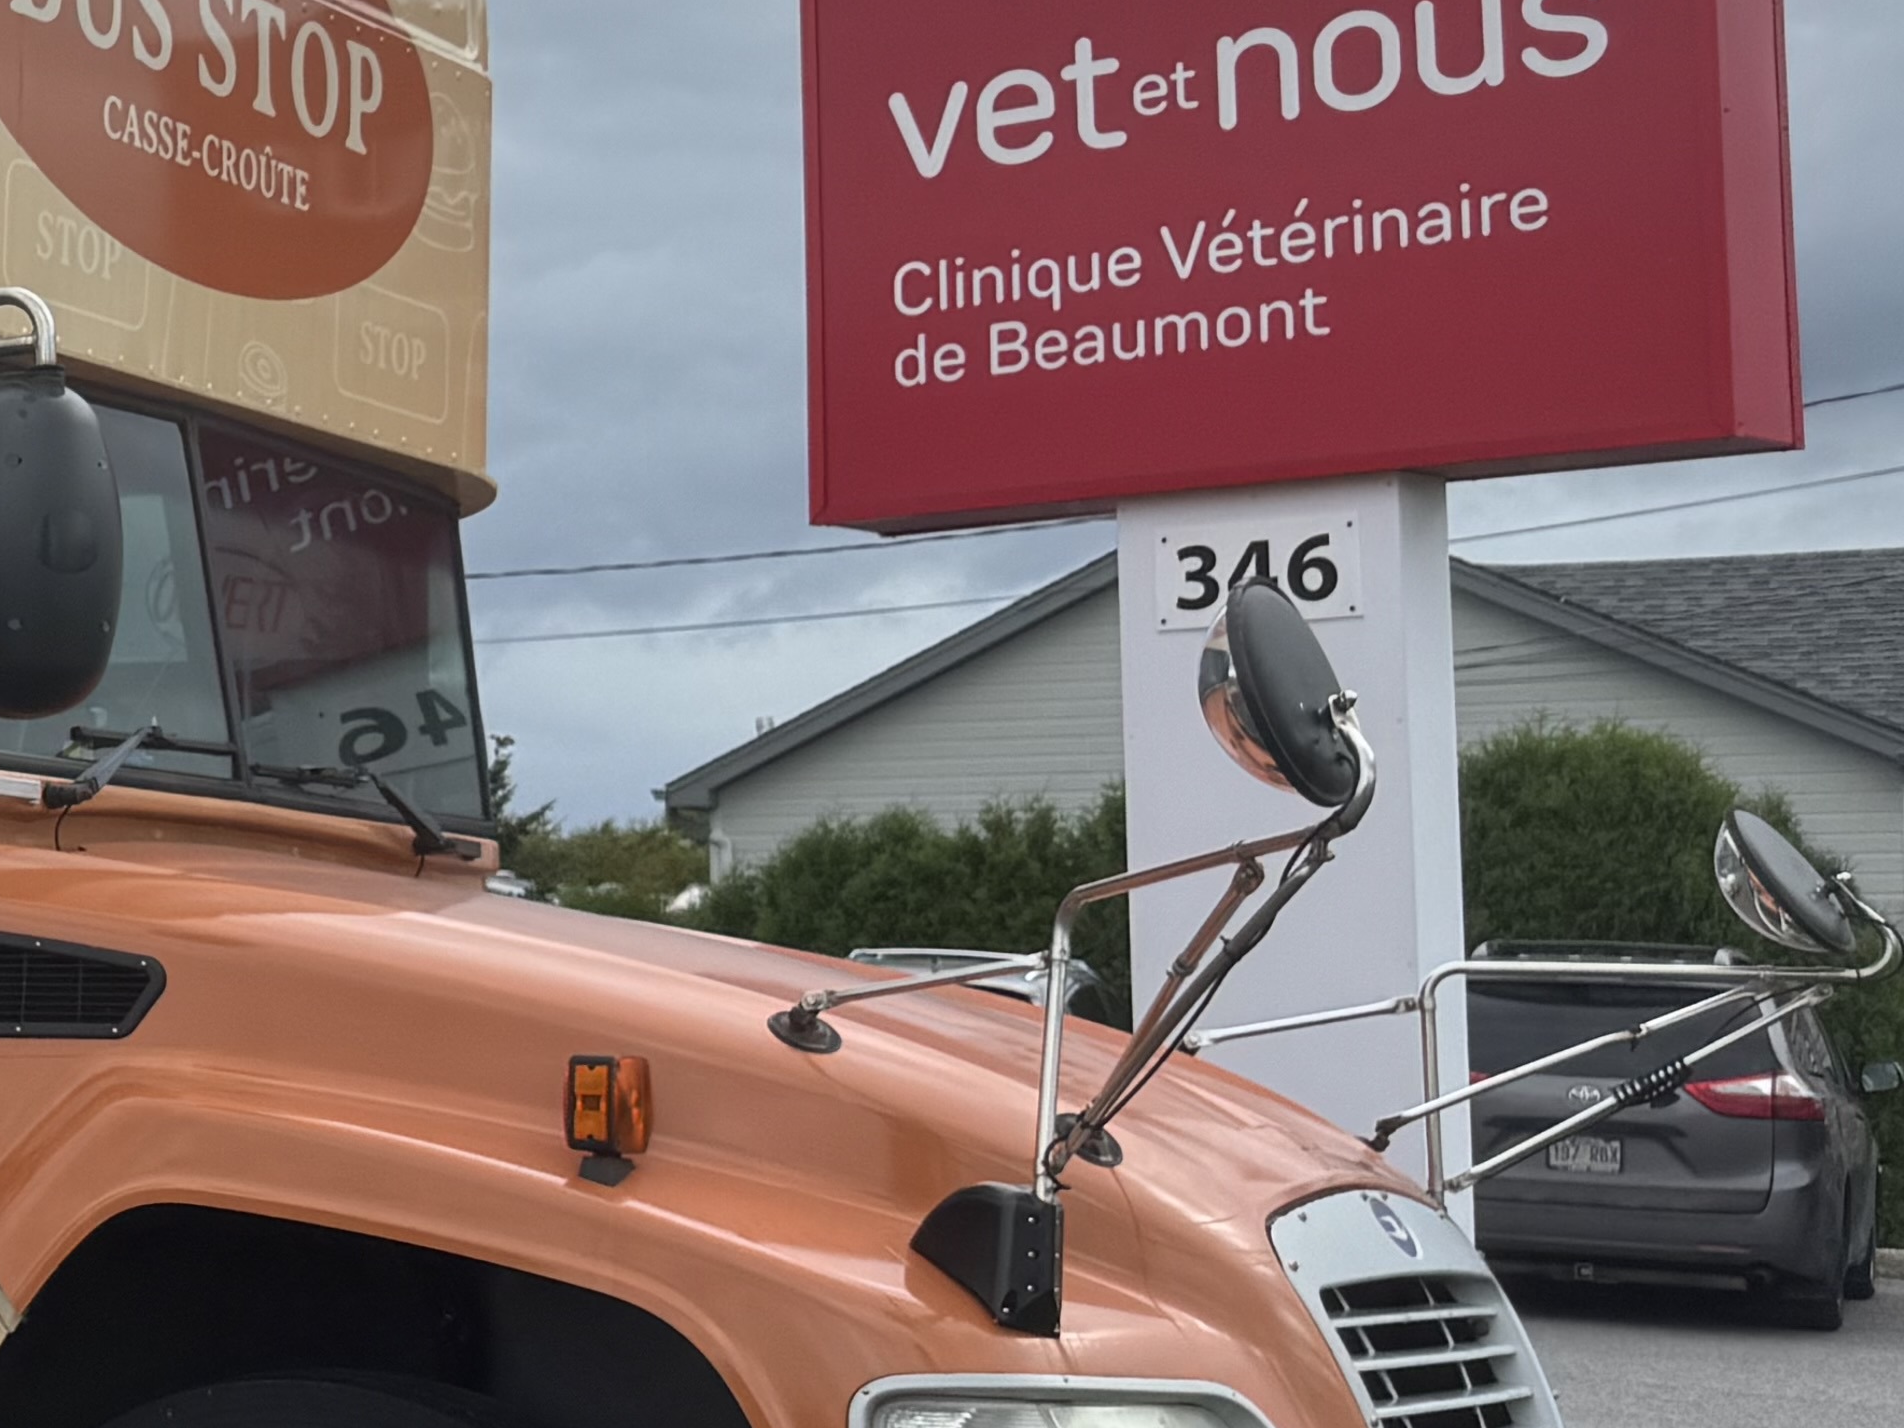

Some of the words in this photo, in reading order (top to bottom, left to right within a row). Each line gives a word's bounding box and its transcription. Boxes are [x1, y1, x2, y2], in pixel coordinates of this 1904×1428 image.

[103, 95, 309, 211] CASSE-CROÛTE
[889, 37, 1127, 178] vet
[1133, 62, 1199, 115] et
[36, 210, 122, 280] STOP
[893, 246, 1142, 316] Clinique
[1161, 183, 1549, 279] Vétérinaire
[360, 321, 426, 381] STOP
[895, 334, 966, 387] de
[990, 289, 1330, 375] Beaumont
[1175, 532, 1339, 611] 346
